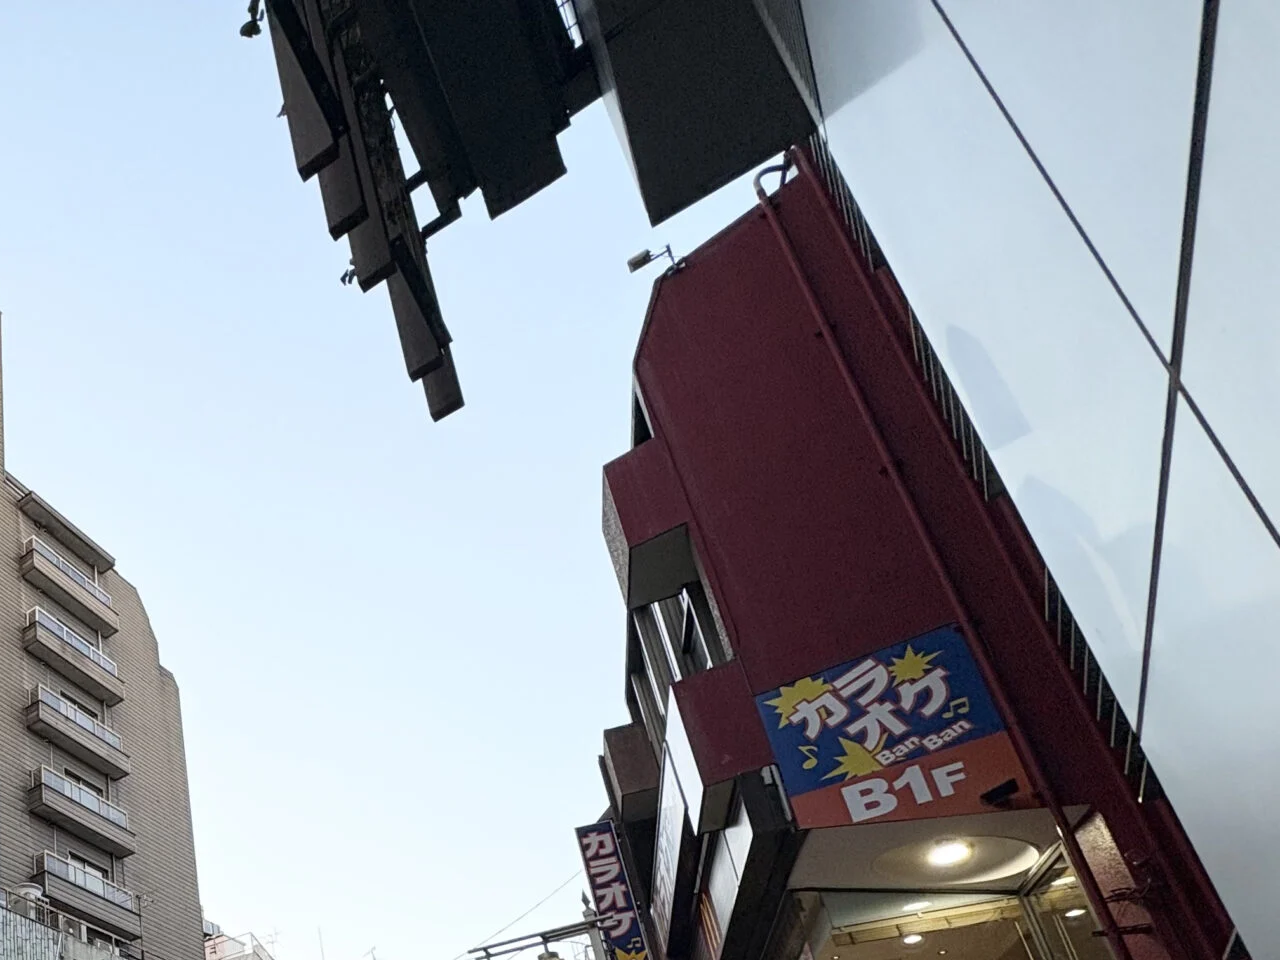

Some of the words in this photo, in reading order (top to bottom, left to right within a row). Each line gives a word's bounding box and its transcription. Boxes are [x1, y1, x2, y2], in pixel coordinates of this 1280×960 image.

[789, 658, 951, 750] カラオケ
[875, 735, 922, 766] Ban
[922, 719, 974, 752] Ban
[840, 761, 968, 824] B1F
[582, 830, 636, 938] カラオケ
